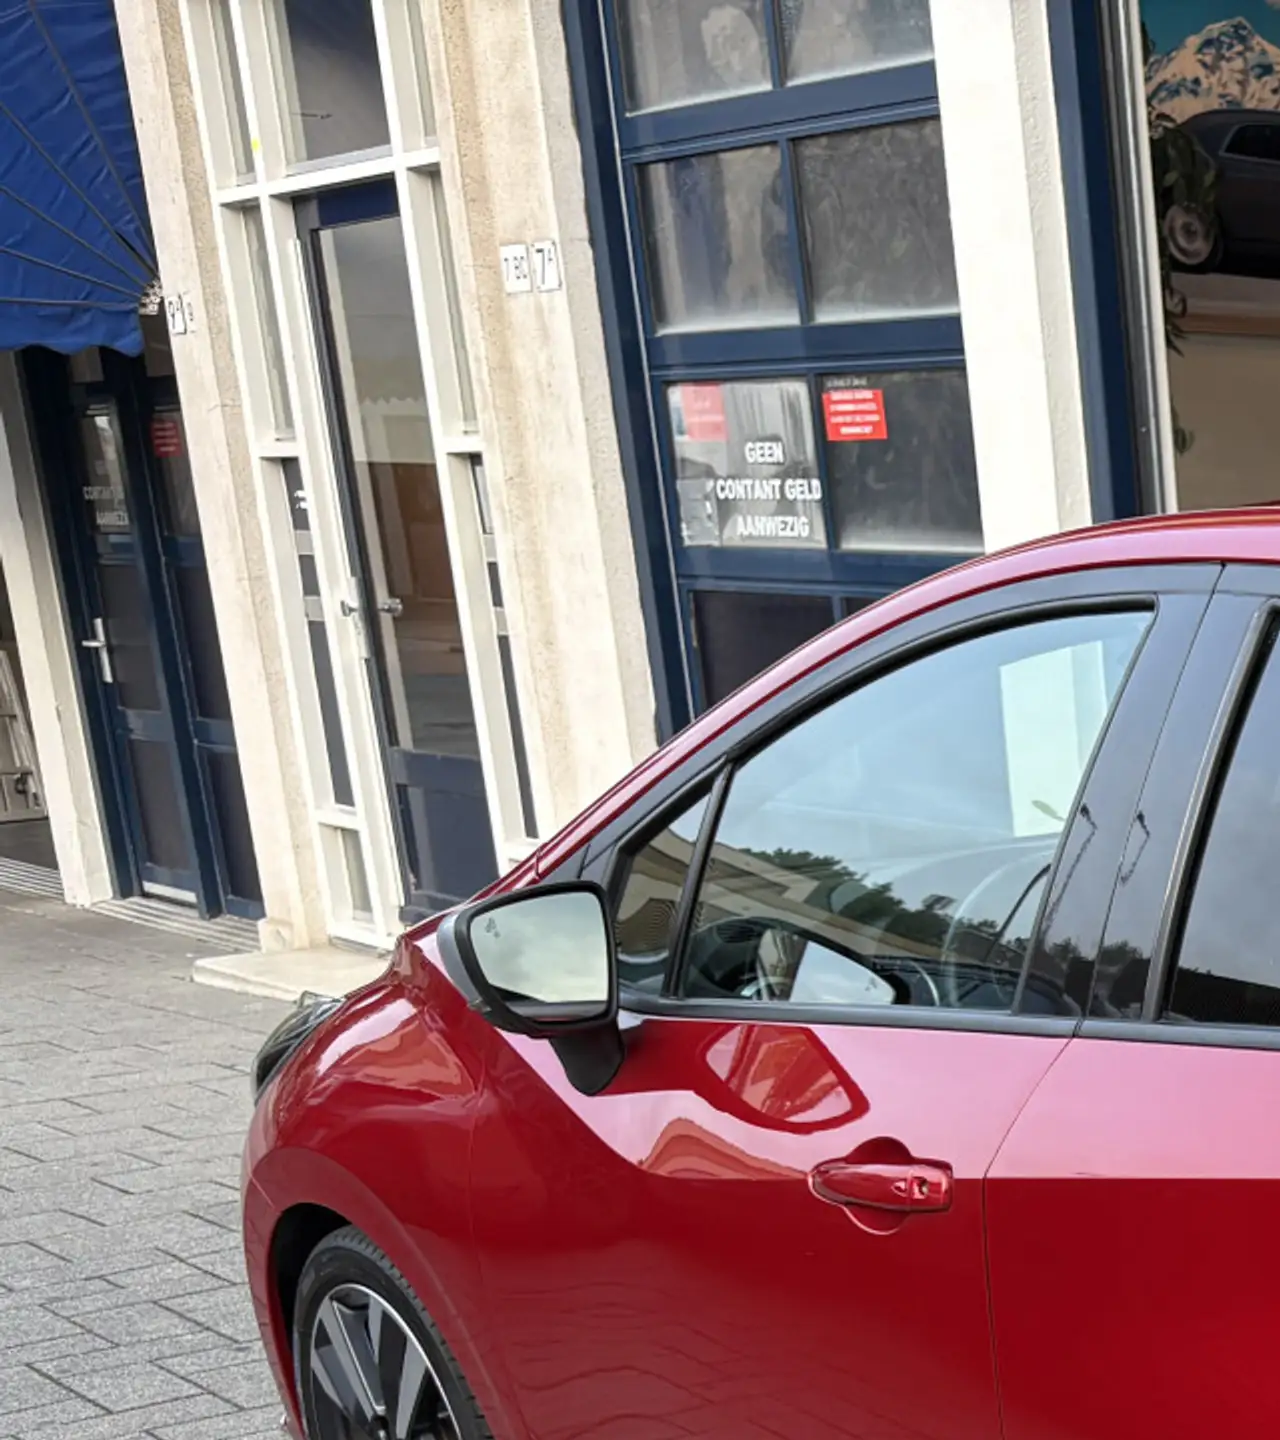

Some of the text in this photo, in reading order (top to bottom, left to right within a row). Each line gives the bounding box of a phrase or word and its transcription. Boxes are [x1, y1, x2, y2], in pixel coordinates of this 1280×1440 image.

[745, 441, 784, 464] GEEN
[716, 479, 822, 500] CONTANT GELD
[737, 515, 810, 537] AANWEZIG
